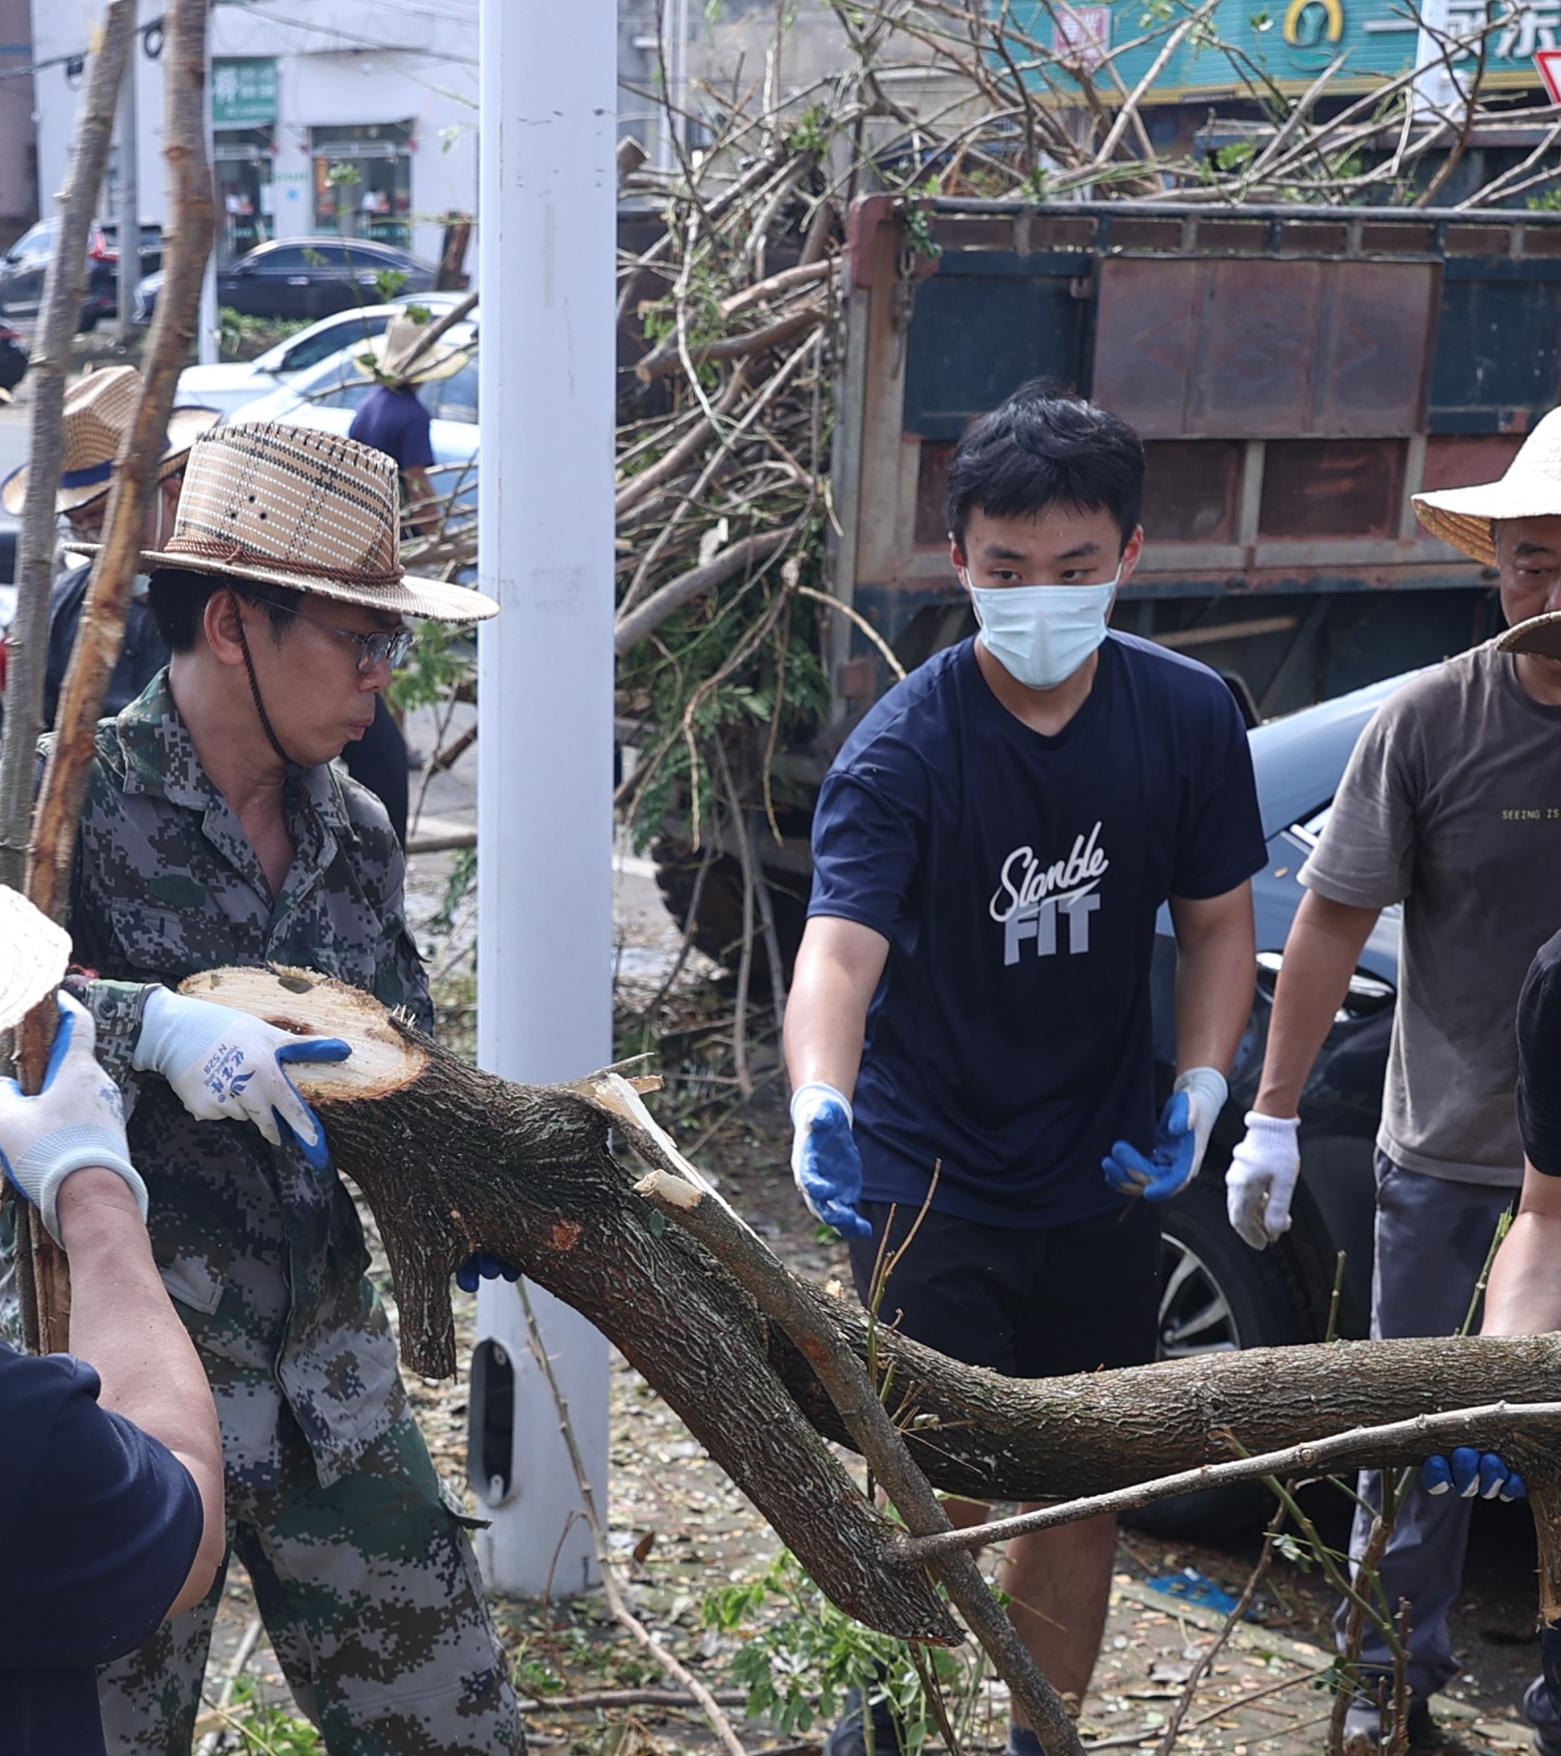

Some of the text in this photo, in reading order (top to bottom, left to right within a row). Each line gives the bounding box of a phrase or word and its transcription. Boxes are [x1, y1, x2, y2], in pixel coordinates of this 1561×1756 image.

[1501, 808, 1541, 821] SEEING
[1546, 807, 1560, 819] IS
[1004, 893, 1101, 967] FIT
